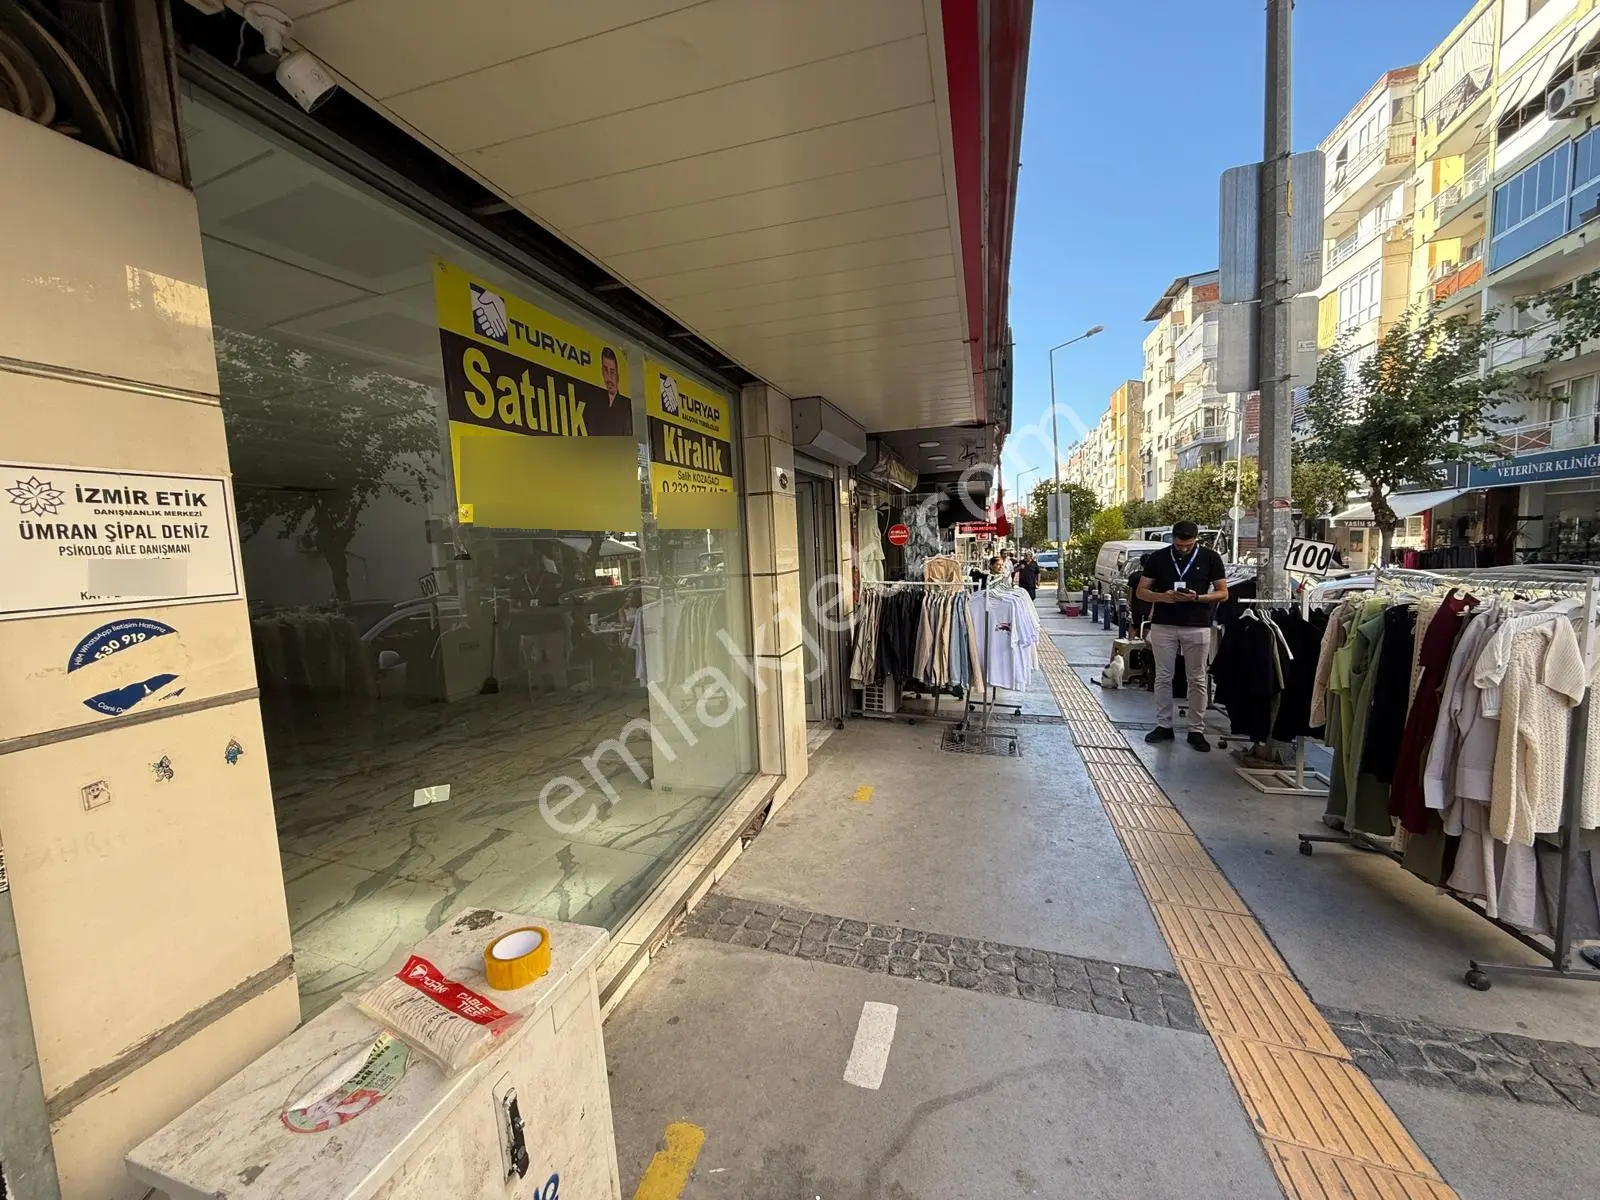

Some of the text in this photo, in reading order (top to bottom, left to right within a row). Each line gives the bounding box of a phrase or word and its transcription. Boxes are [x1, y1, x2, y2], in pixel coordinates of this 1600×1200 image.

[509, 317, 592, 367] TURYAP
[462, 346, 589, 437] Satılık
[678, 392, 720, 422] TURYAP
[663, 424, 723, 473] Kiralık
[1497, 461, 1553, 477] VETERİNER
[75, 483, 208, 508] İZMİR ETİK
[94, 508, 162, 517] DANIŞMANLIK
[19, 520, 209, 542] ÜMRAN ŞİPAL DENİZ
[58, 543, 191, 557] PSİKOLOG AİLE DANIŞMANI
[1290, 542, 1331, 570] 100
[81, 629, 113, 654] WhatsApp
[112, 622, 138, 632] İletişim
[121, 632, 146, 645] 919
[456, 992, 491, 1014] CABLE
[456, 1000, 481, 1017] TIES
